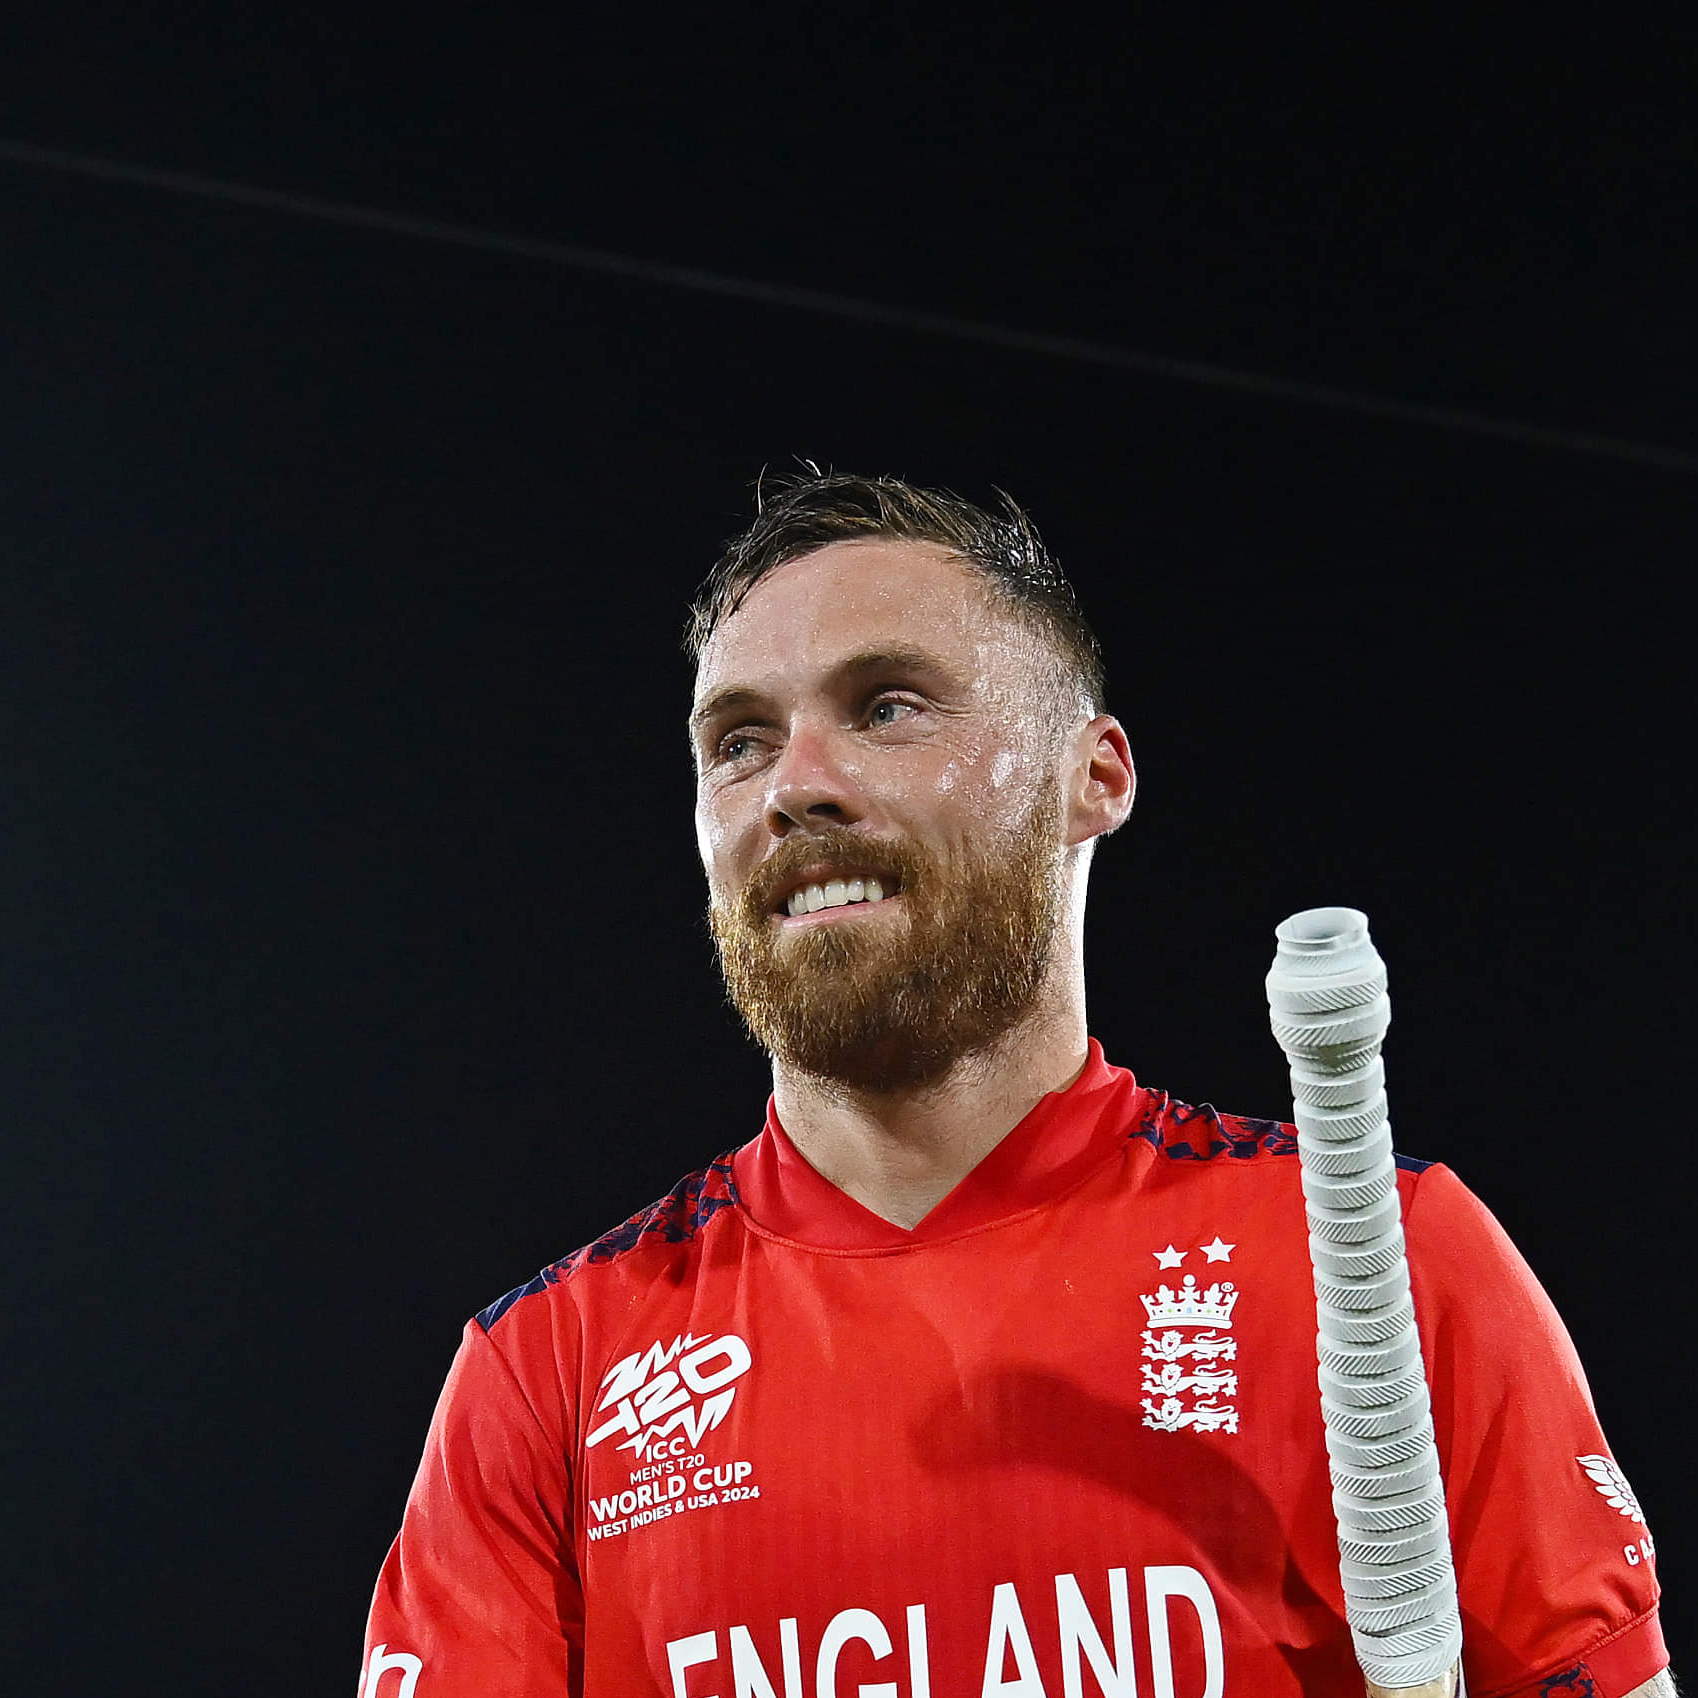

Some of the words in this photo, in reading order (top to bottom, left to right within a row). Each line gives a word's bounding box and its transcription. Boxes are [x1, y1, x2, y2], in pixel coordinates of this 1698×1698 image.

[630, 1460, 675, 1485] MEN'S
[676, 1453, 705, 1472] T20
[646, 1436, 686, 1463] ICC
[587, 1519, 628, 1541] WEST
[630, 1504, 673, 1530] INDIES
[674, 1499, 685, 1513] &
[687, 1492, 719, 1509] USA
[722, 1485, 760, 1505] 2024
[590, 1475, 686, 1522] WORLD
[693, 1461, 752, 1491] CUP
